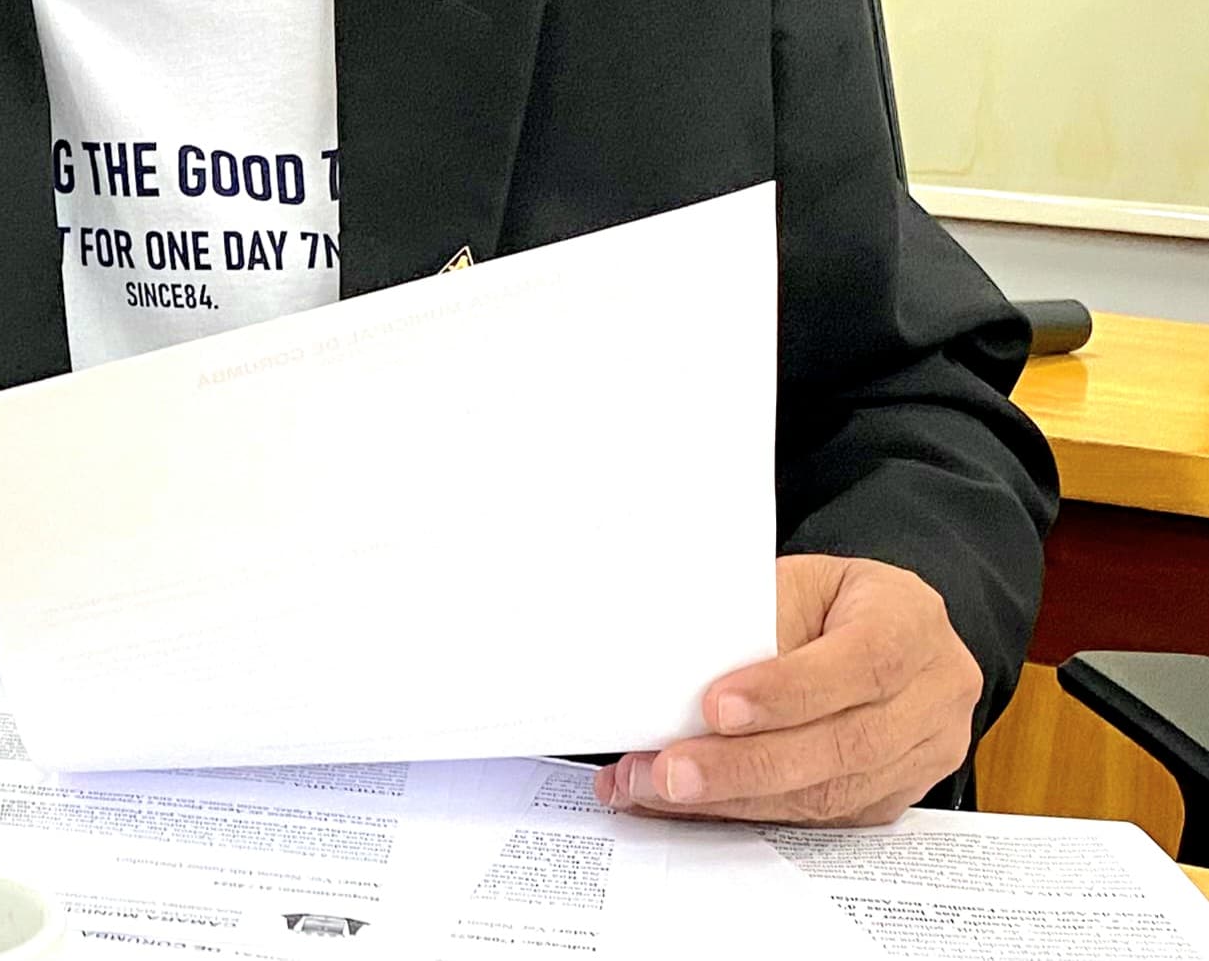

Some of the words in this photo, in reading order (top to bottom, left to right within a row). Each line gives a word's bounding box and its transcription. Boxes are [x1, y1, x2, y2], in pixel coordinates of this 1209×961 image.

[82, 142, 160, 197] THE
[178, 145, 305, 205] GOOD
[81, 227, 135, 269] FOR
[146, 231, 212, 271] ONE
[224, 231, 288, 271] DAY
[126, 282, 219, 310] SINCE84.
